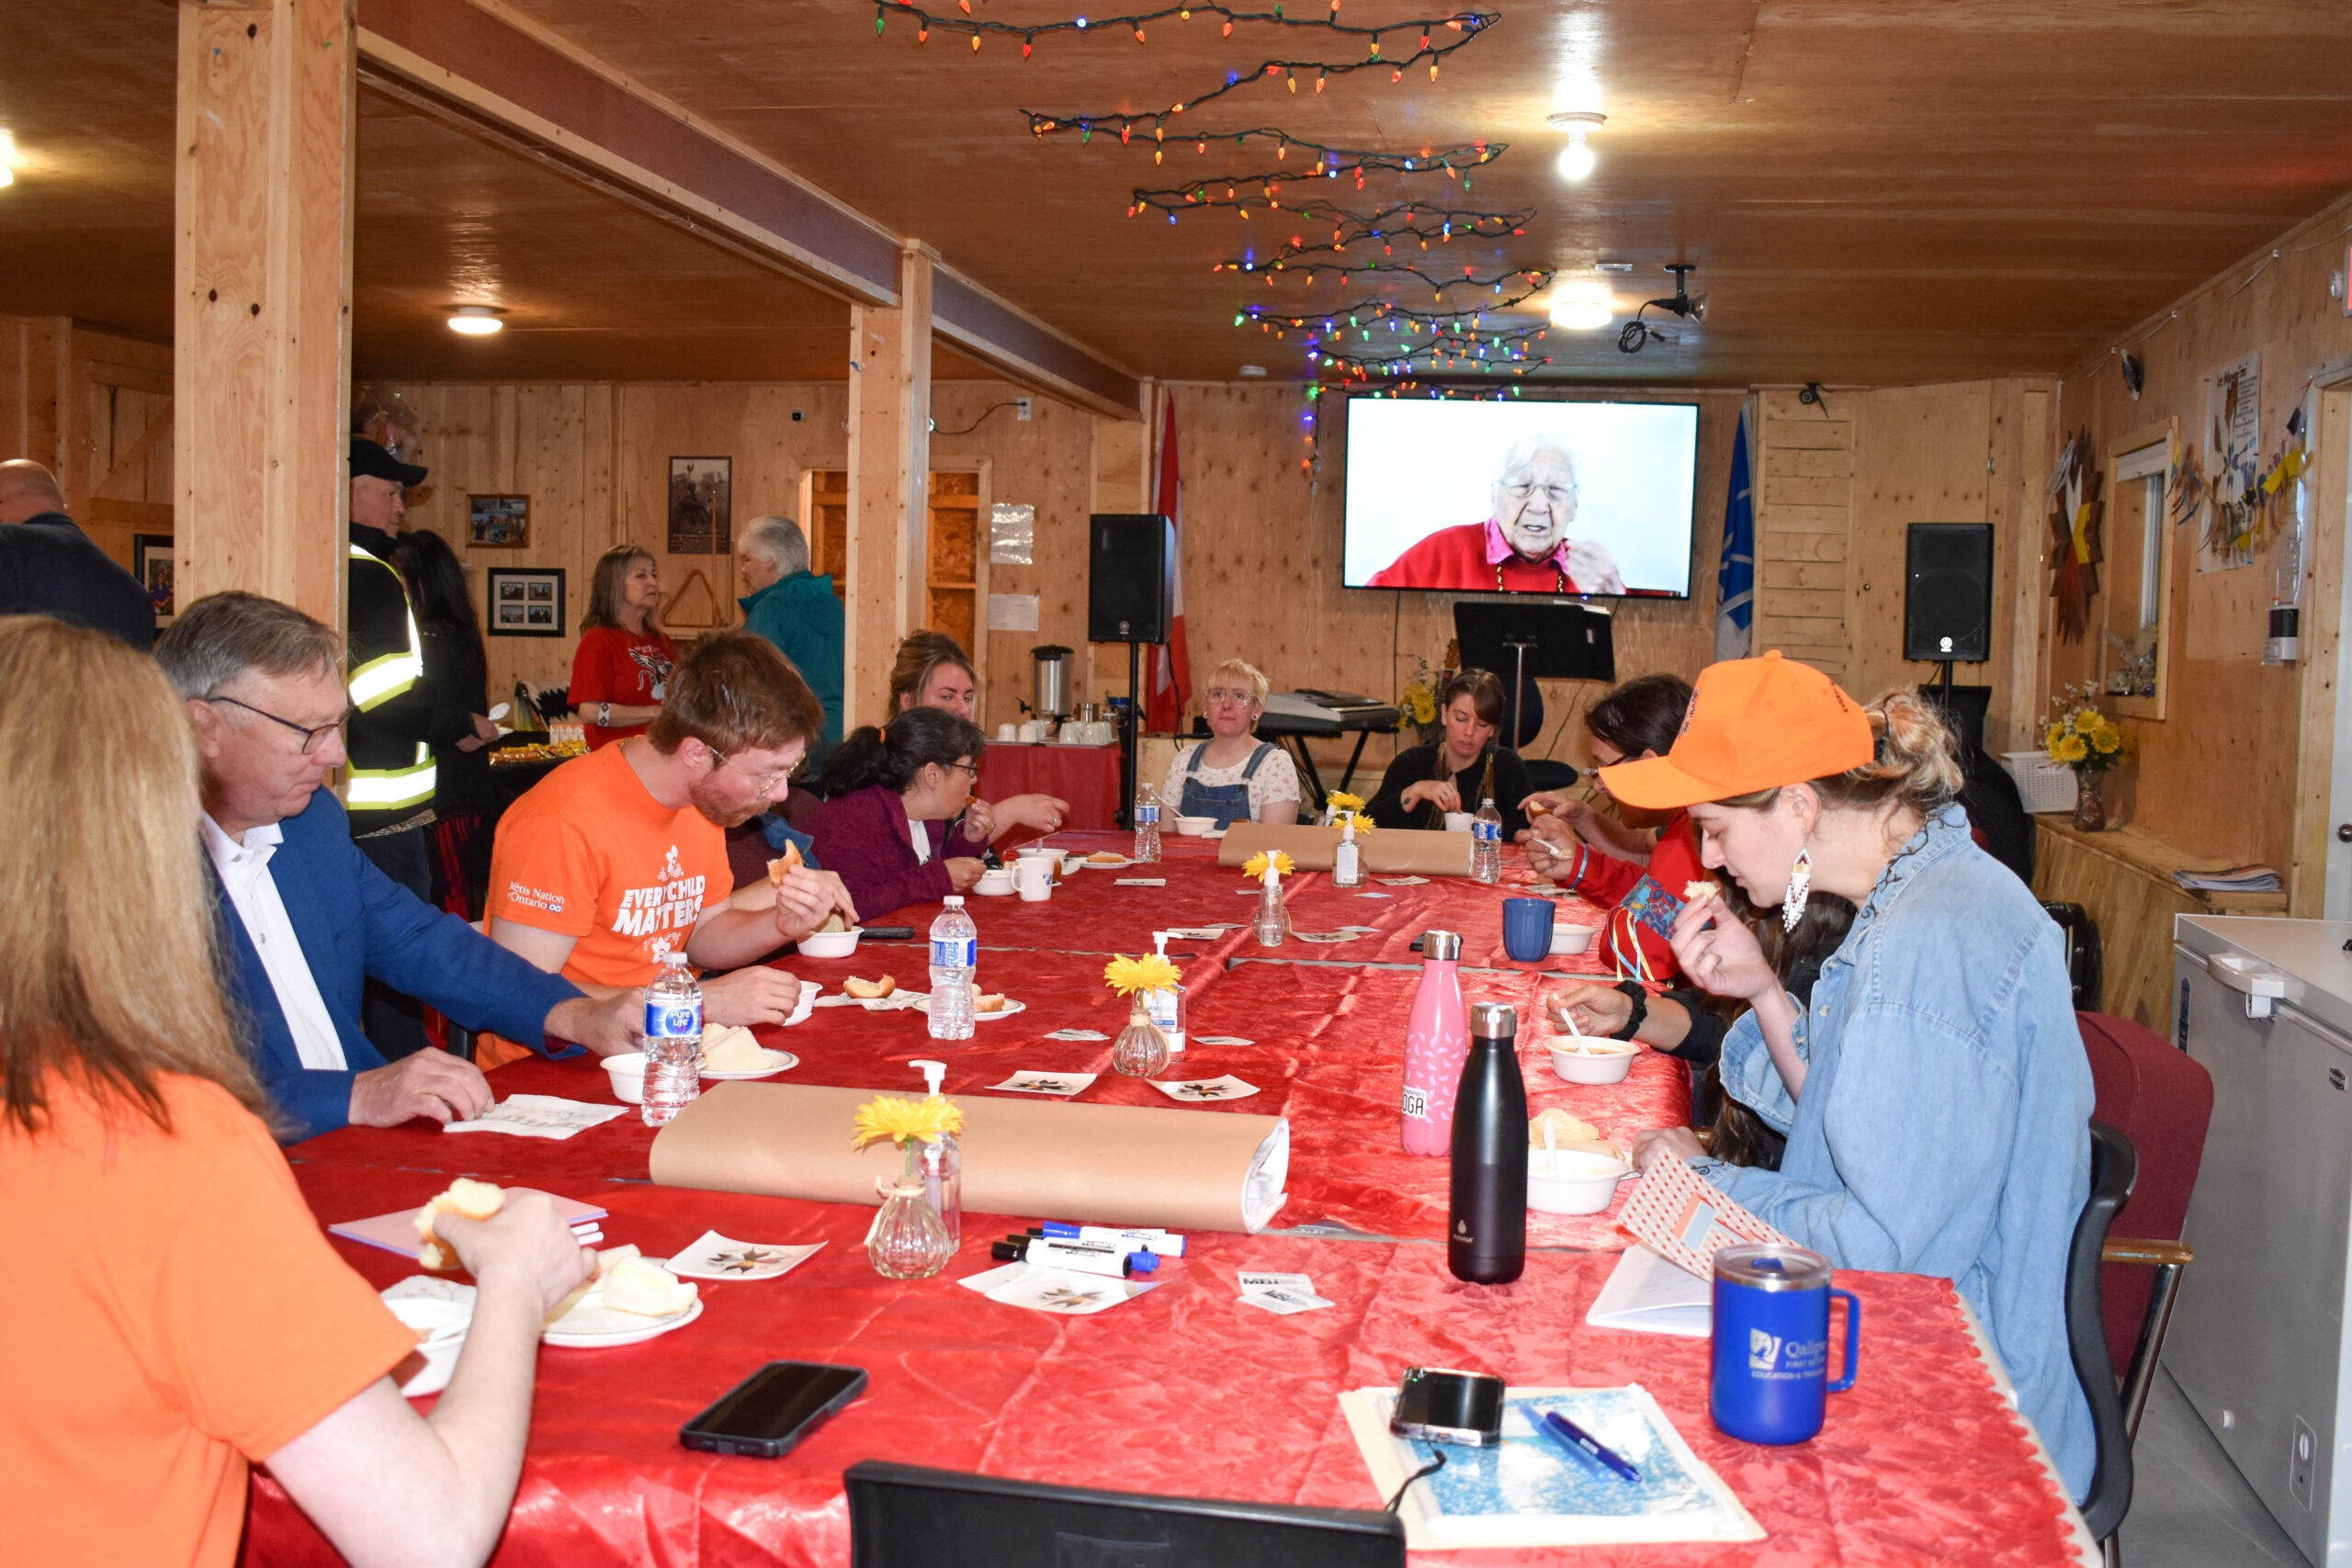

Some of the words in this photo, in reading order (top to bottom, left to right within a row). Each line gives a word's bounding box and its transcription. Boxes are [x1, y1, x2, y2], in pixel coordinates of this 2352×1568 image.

[510, 891, 548, 909] Ontario
[533, 887, 565, 904] Nation
[620, 885, 669, 908] EVERY
[667, 875, 706, 901] CHILD
[611, 895, 704, 936] MATTERS
[671, 1010, 690, 1019] Pure
[673, 1019, 688, 1027] Life
